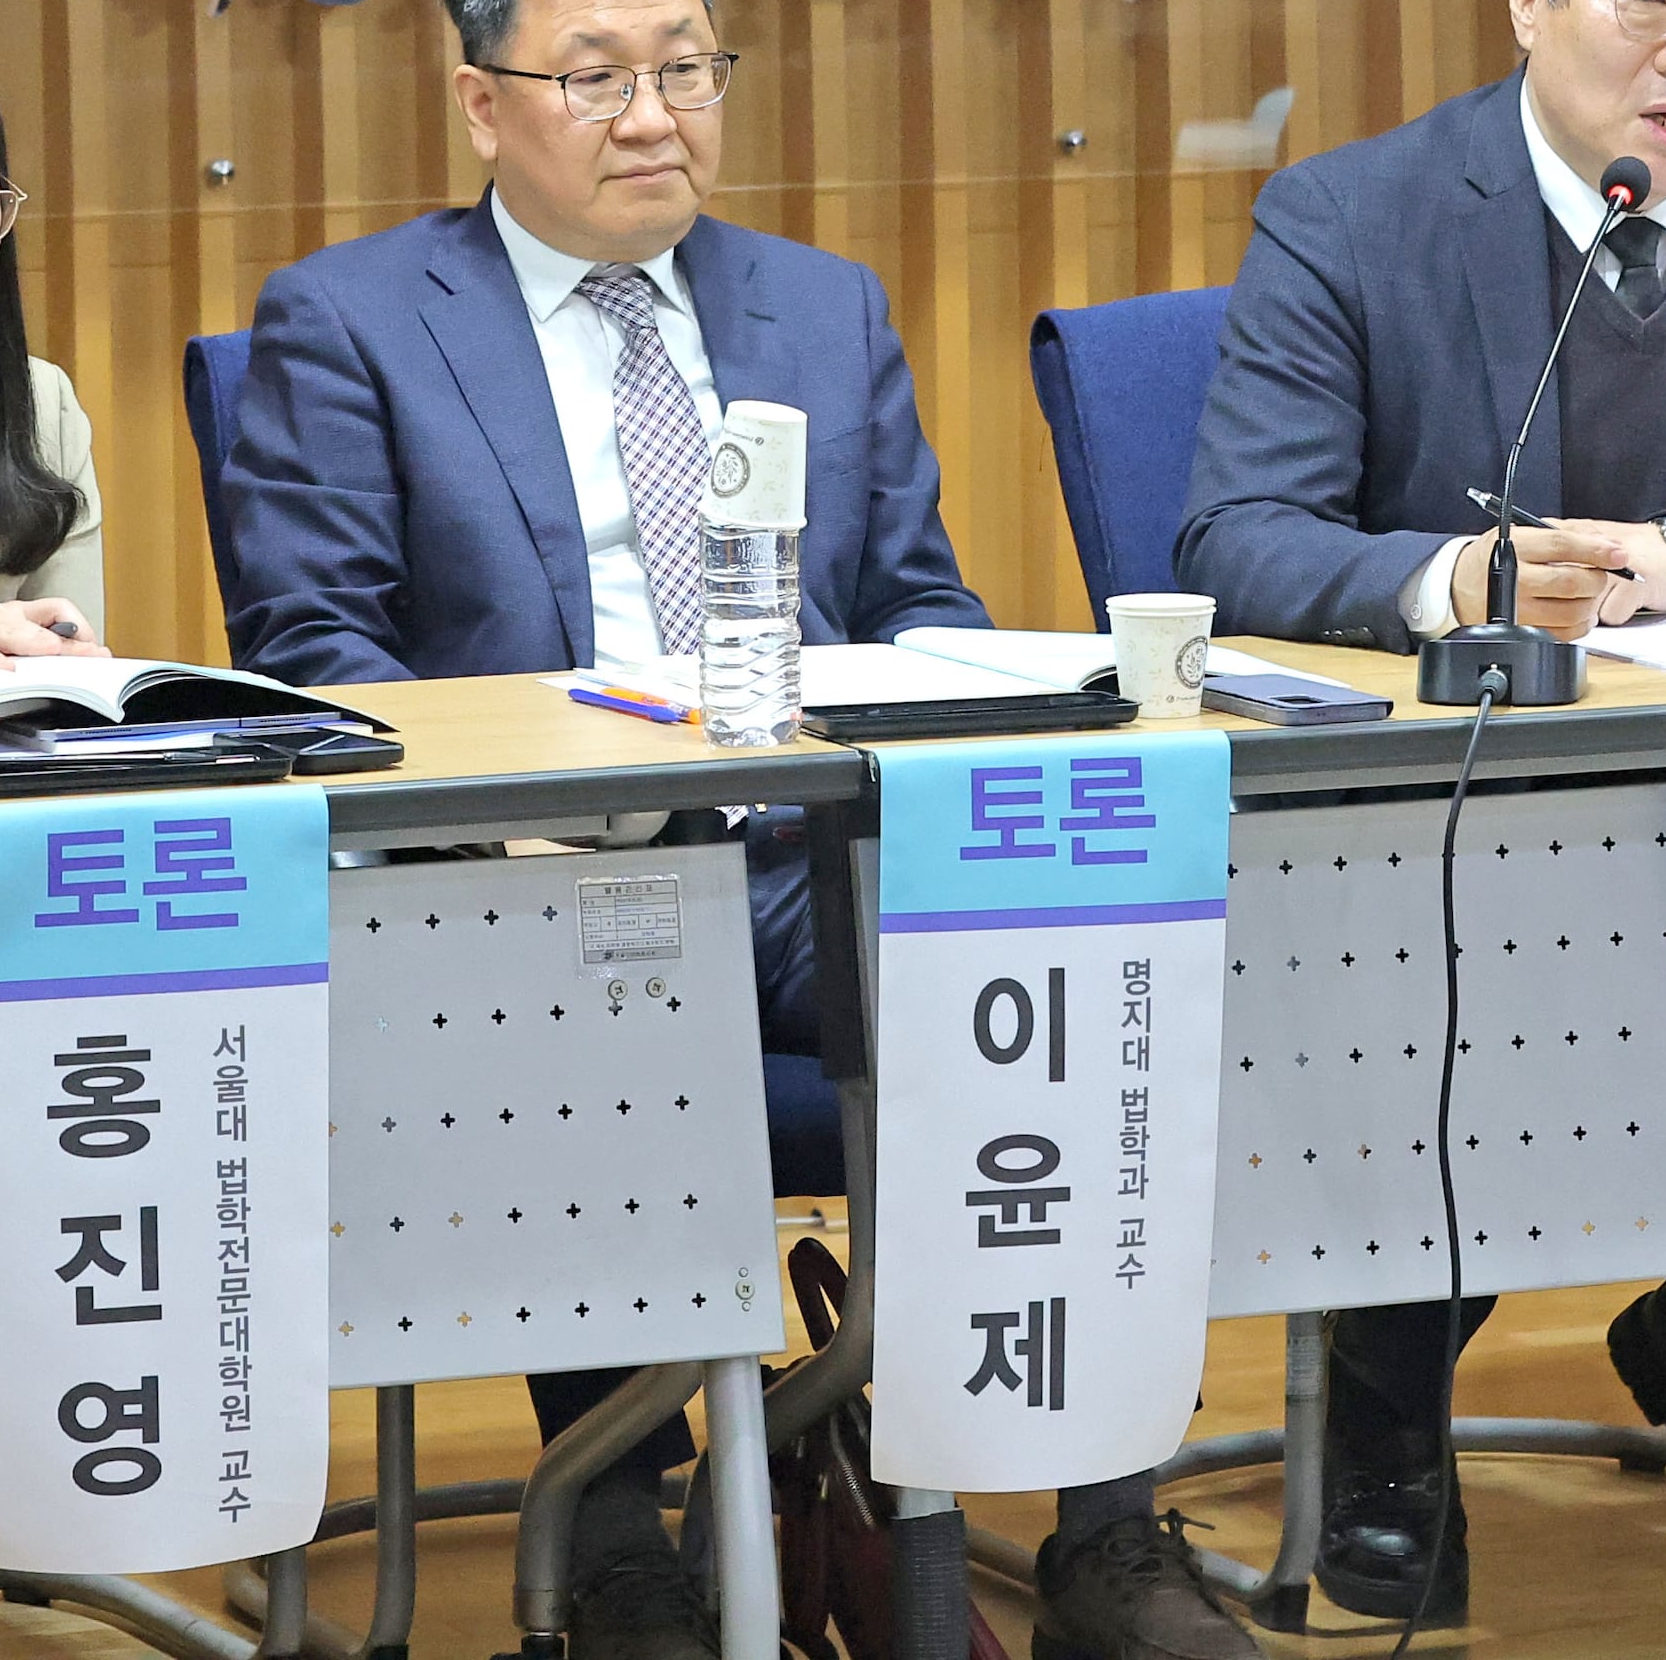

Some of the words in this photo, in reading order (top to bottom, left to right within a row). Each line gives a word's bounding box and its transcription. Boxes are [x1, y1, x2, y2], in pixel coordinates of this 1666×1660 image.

[960, 757, 1156, 865] 토론
[35, 818, 247, 930] 토론
[1122, 959, 1150, 1071] 명지대
[213, 1025, 248, 1141] 서울대
[964, 968, 1070, 1411] 이윤제
[1118, 1087, 1150, 1199] 법학과
[47, 1035, 162, 1495] 홍진영
[217, 1158, 252, 1432] 법학전문대학원
[1116, 1219, 1146, 1289] 교수
[219, 1451, 251, 1522] 교수
